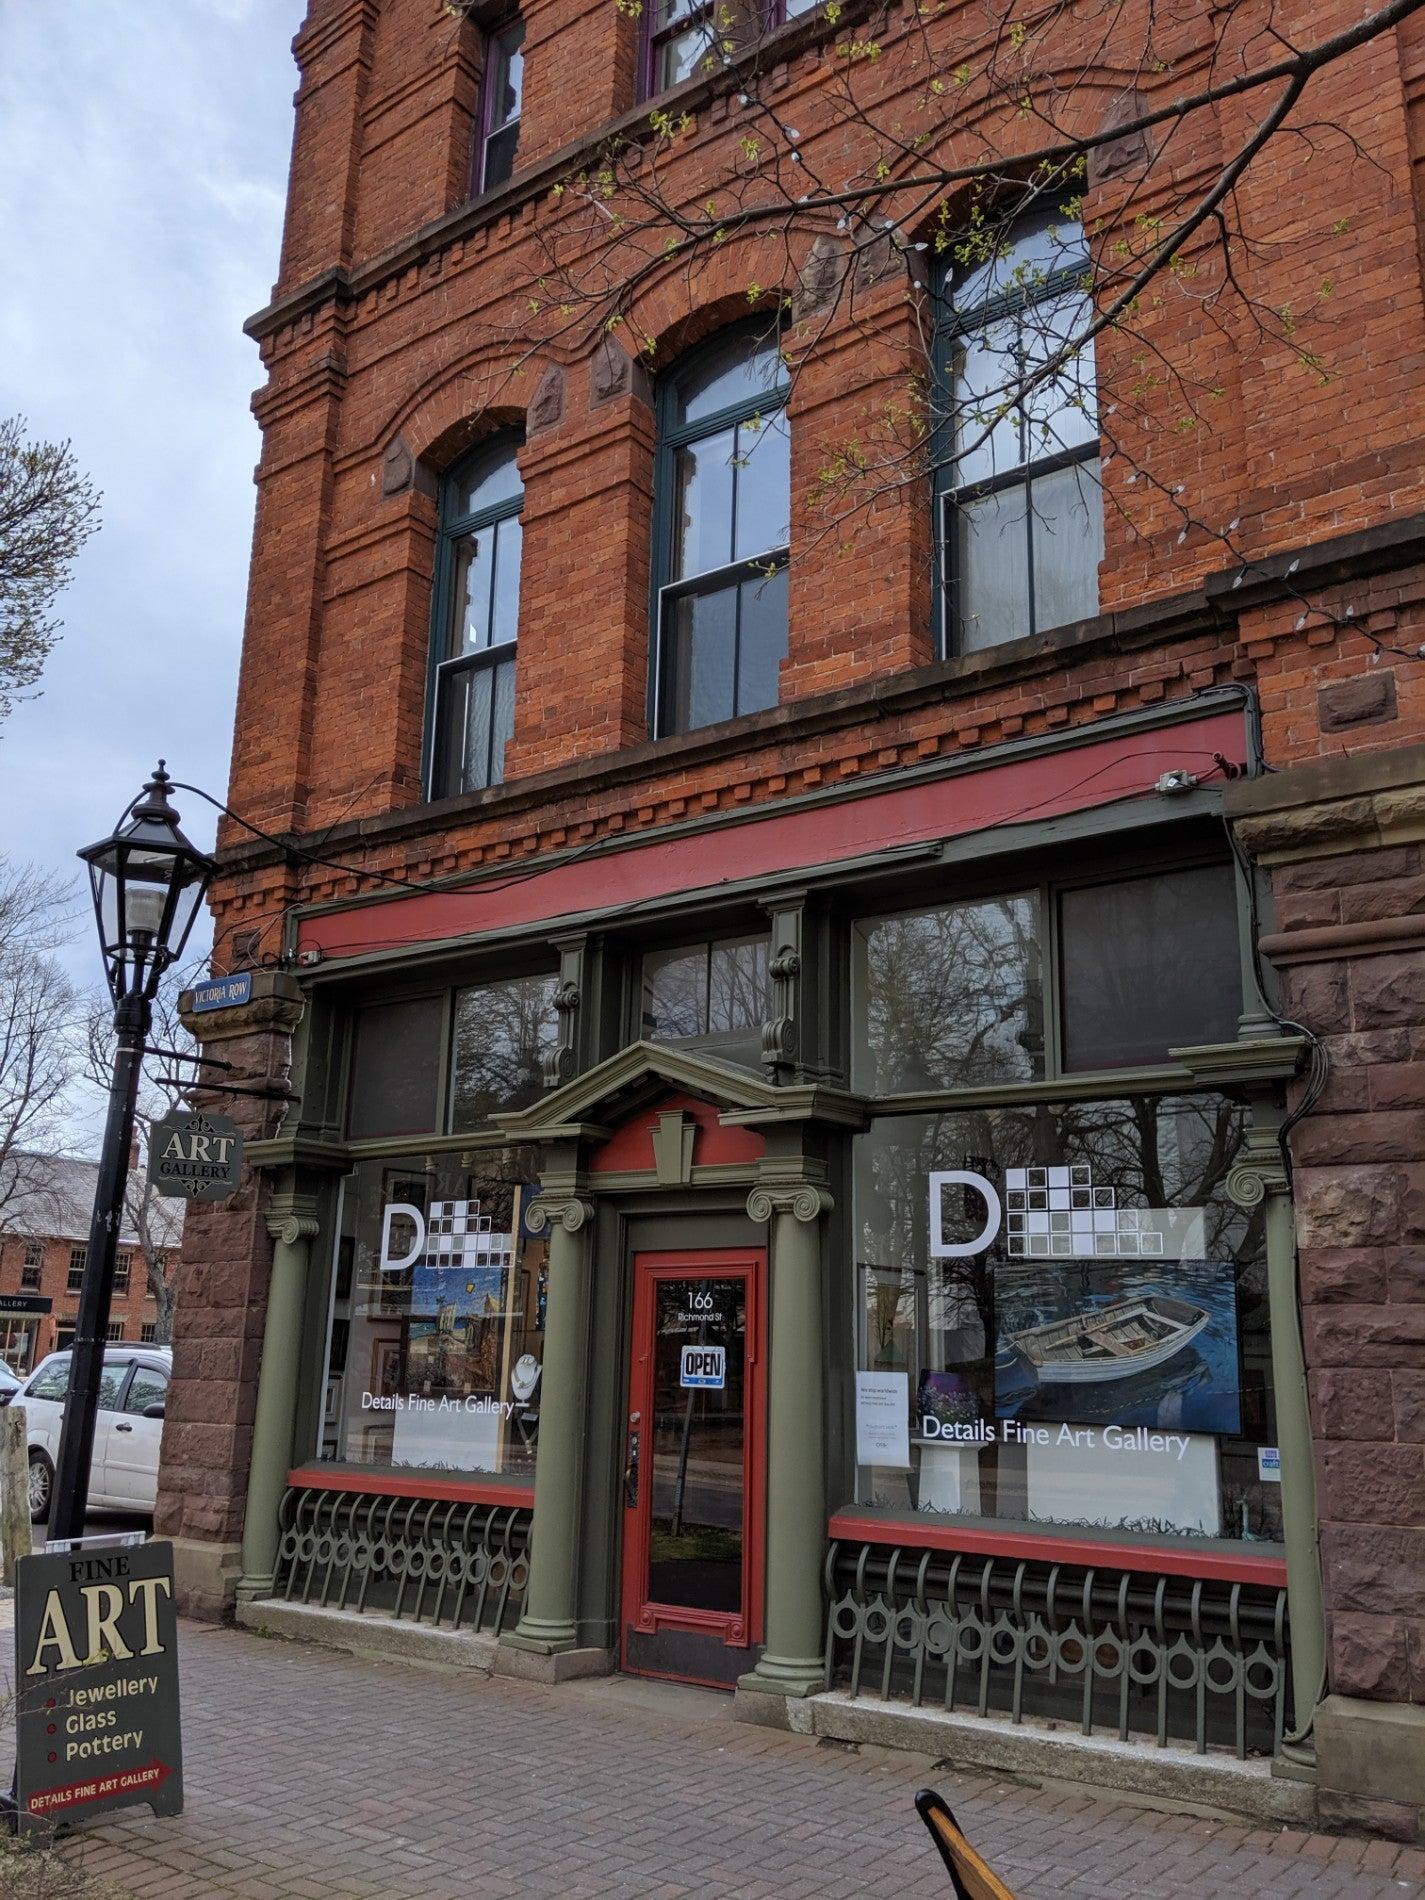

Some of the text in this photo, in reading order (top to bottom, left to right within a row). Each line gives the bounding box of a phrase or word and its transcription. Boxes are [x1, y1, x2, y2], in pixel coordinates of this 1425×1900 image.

[194, 980, 248, 1004] VICTORIA ROW
[160, 1132, 235, 1164] ART
[159, 1161, 231, 1179] GALLERY
[688, 1292, 713, 1309] 166
[678, 1312, 713, 1321] Richmond
[685, 1352, 720, 1376] OPEN
[361, 1391, 515, 1420] Details Fine Art Gallery
[922, 1415, 1191, 1460] Details Fine Art Gallery
[69, 1556, 130, 1582] FINE
[26, 1576, 171, 1675] ART
[68, 1676, 158, 1708] Jewellery
[66, 1710, 117, 1735] Glass
[66, 1729, 143, 1762] Pottery
[31, 1767, 160, 1810] DETAILS FINE ART GALLERY
